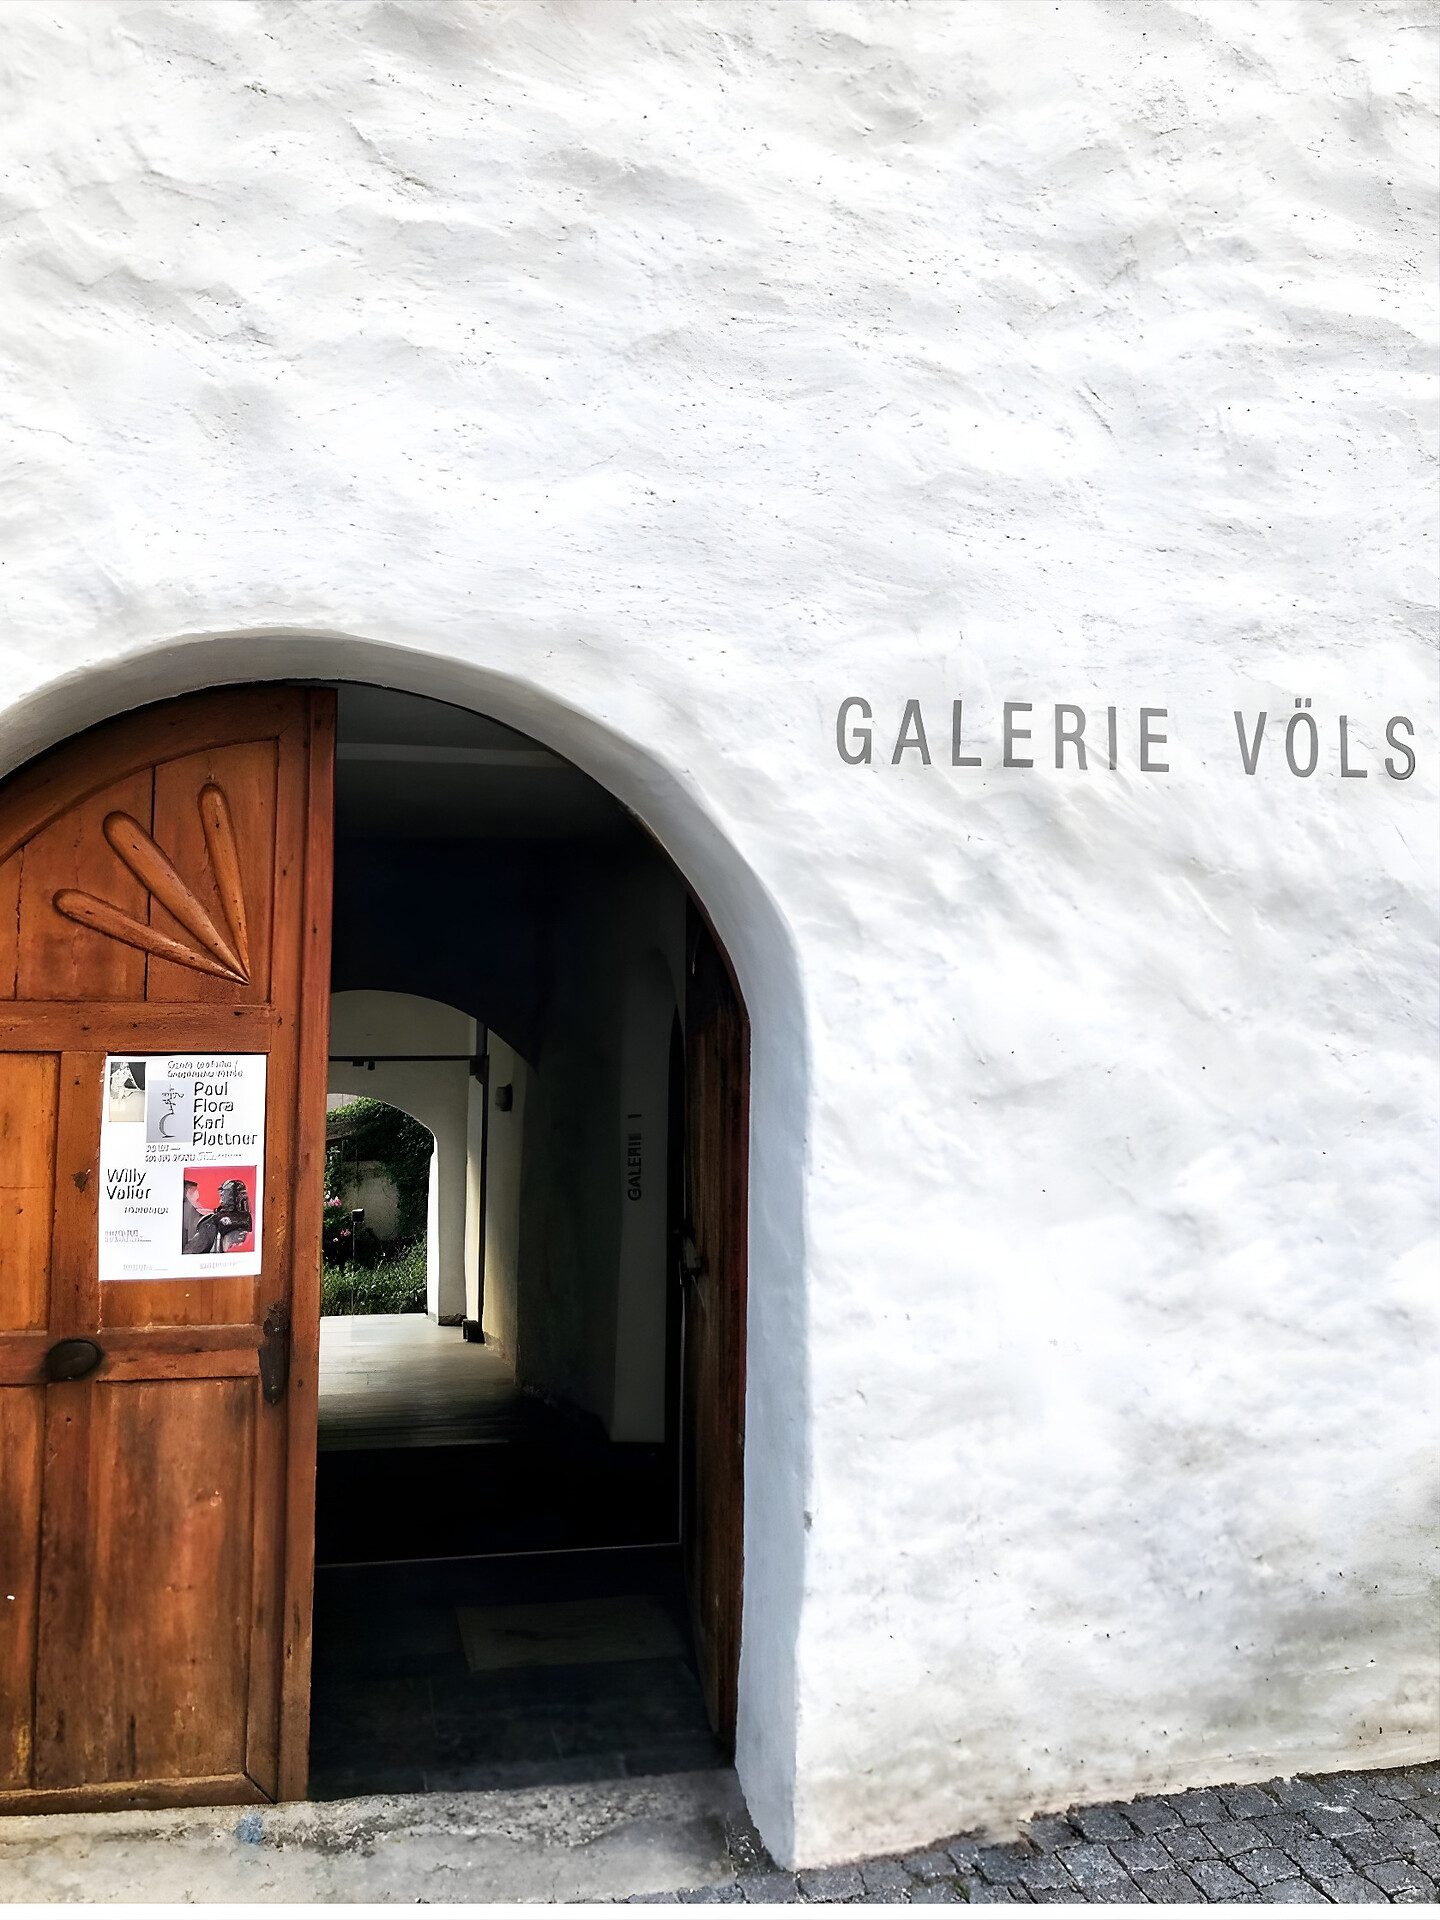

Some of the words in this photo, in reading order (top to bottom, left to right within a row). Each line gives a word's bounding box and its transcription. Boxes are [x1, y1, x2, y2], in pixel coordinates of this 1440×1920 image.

[836, 696, 1169, 773] GALERIE
[1234, 698, 1416, 781] VÖLS
[193, 1081, 228, 1097] Paul
[193, 1098, 234, 1113] Flora
[192, 1132, 258, 1147] Plattner
[627, 1133, 642, 1201] GALERIE
[107, 1168, 147, 1187] Willy
